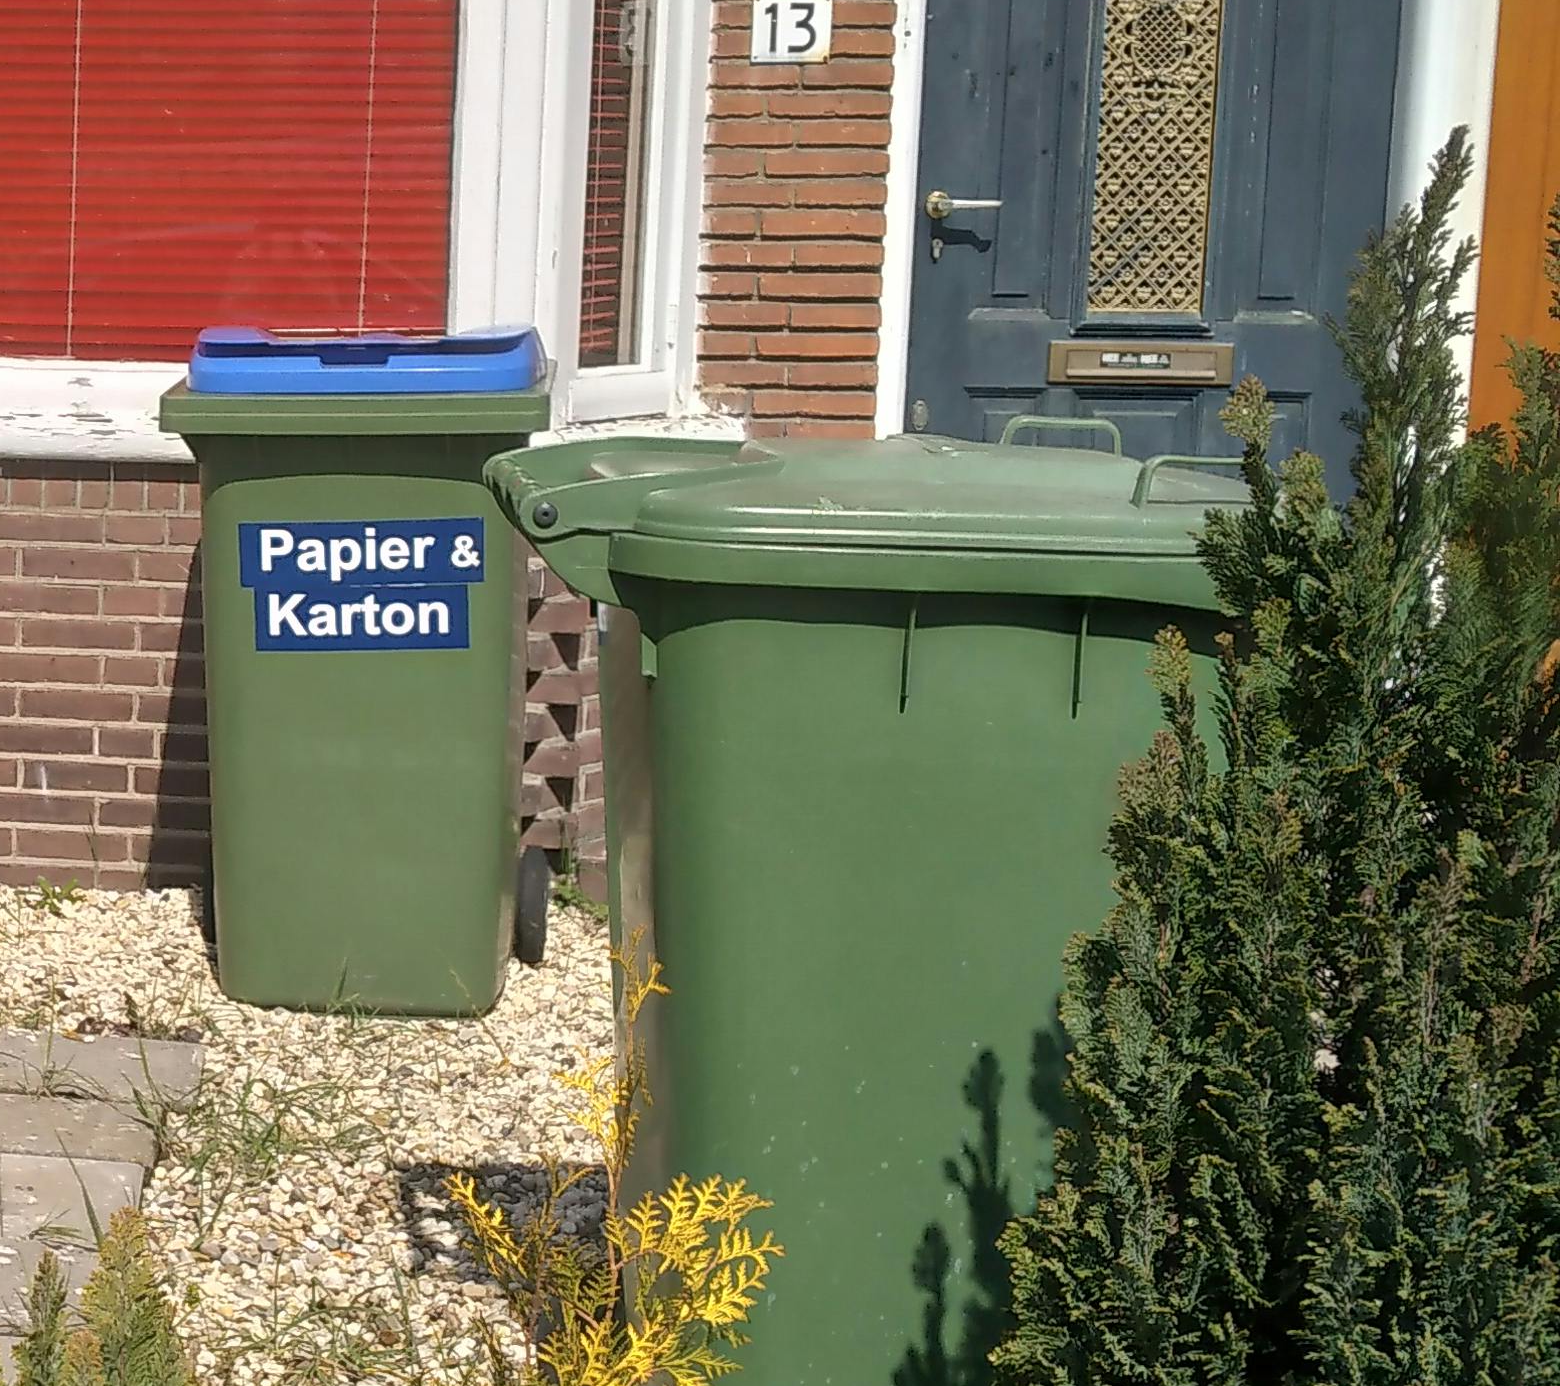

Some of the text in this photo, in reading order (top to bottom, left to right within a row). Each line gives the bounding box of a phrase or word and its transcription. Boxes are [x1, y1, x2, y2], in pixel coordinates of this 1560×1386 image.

[764, 2, 817, 54] 13
[259, 527, 481, 582] Papier &
[268, 593, 450, 637] Karton
